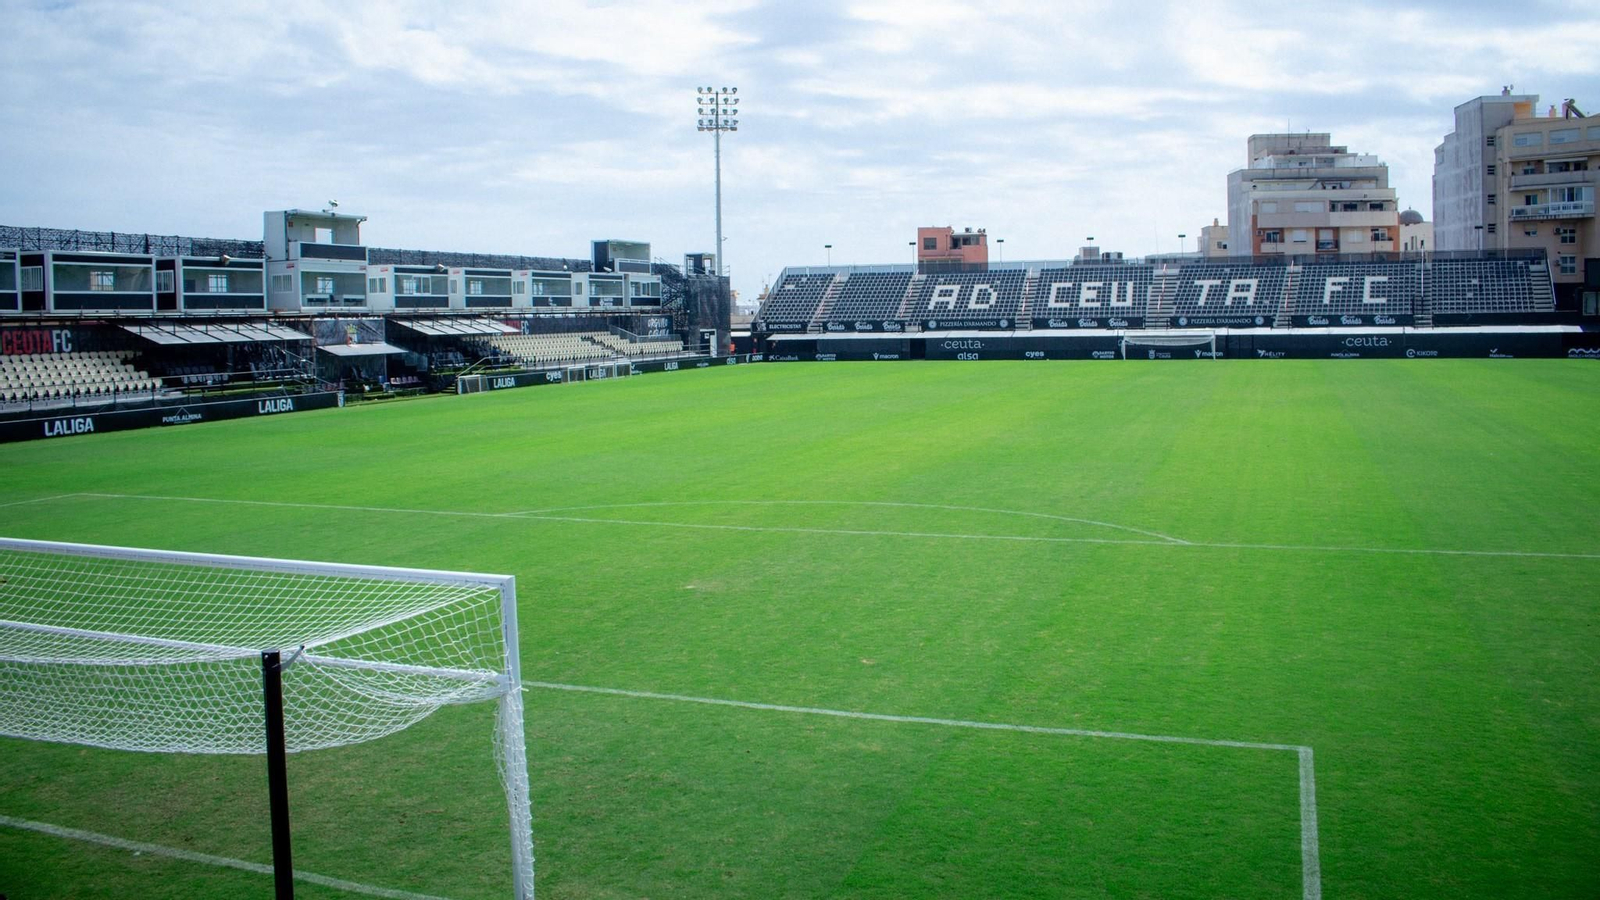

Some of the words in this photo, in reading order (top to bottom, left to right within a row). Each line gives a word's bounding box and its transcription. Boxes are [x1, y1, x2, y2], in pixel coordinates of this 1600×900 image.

[928, 283, 998, 310] AD
[1323, 276, 1388, 304] FC
[957, 352, 979, 360] alsa
[494, 377, 516, 388] LALIGA
[258, 399, 293, 413] LALIGA
[44, 417, 94, 436] LALIGA
